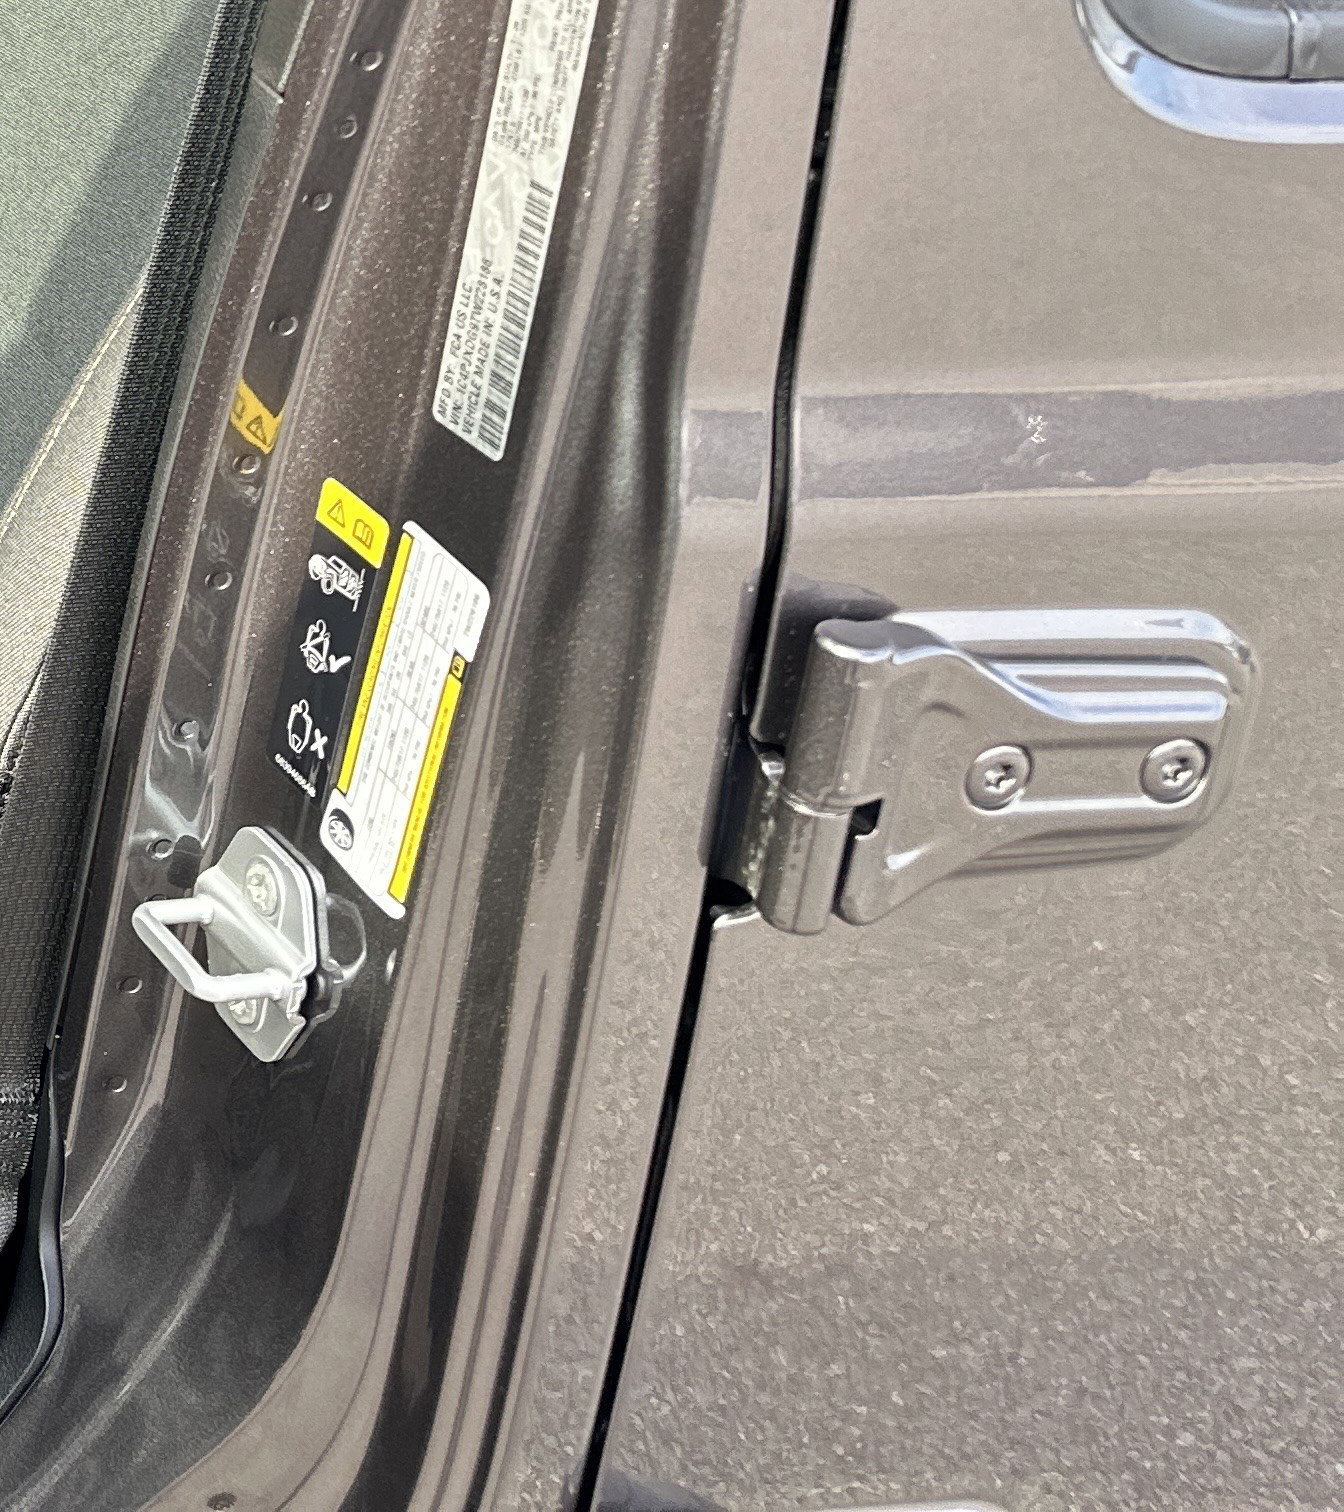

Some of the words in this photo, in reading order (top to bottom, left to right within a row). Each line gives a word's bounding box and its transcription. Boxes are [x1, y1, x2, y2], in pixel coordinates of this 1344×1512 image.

[454, 307, 467, 331] US
[448, 329, 463, 360] FCA
[461, 377, 482, 438] VEHICLE
[473, 336, 490, 380] MADE
